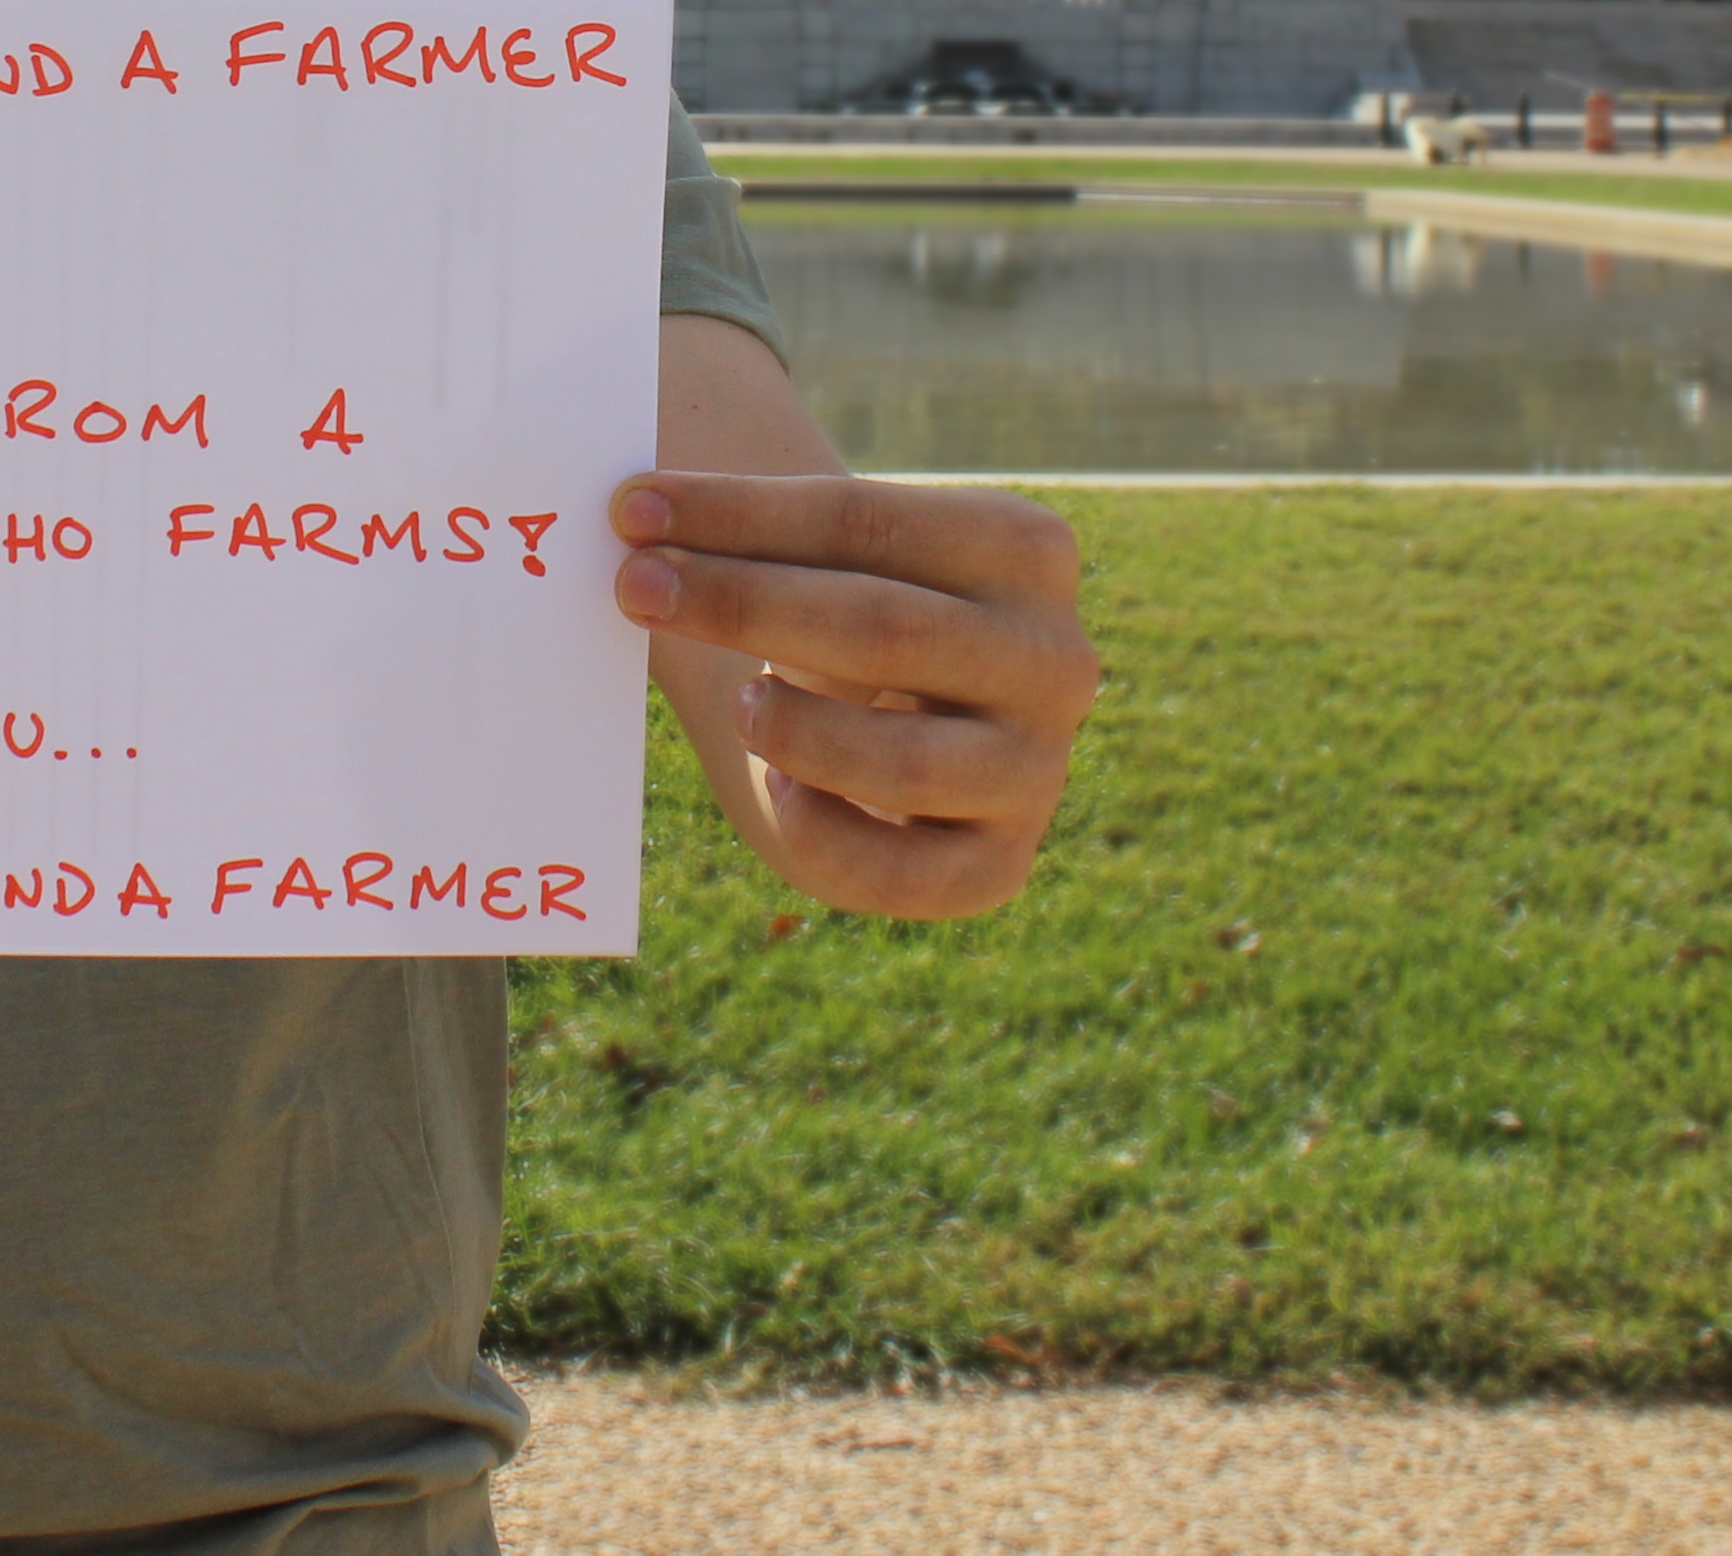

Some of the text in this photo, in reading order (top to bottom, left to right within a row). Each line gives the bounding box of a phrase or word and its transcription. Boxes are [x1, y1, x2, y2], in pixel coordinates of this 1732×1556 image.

[121, 30, 180, 94] A
[226, 21, 628, 91] FARMER
[300, 388, 364, 454] A
[167, 502, 558, 578] FARMS!
[211, 850, 588, 922] FARMER
